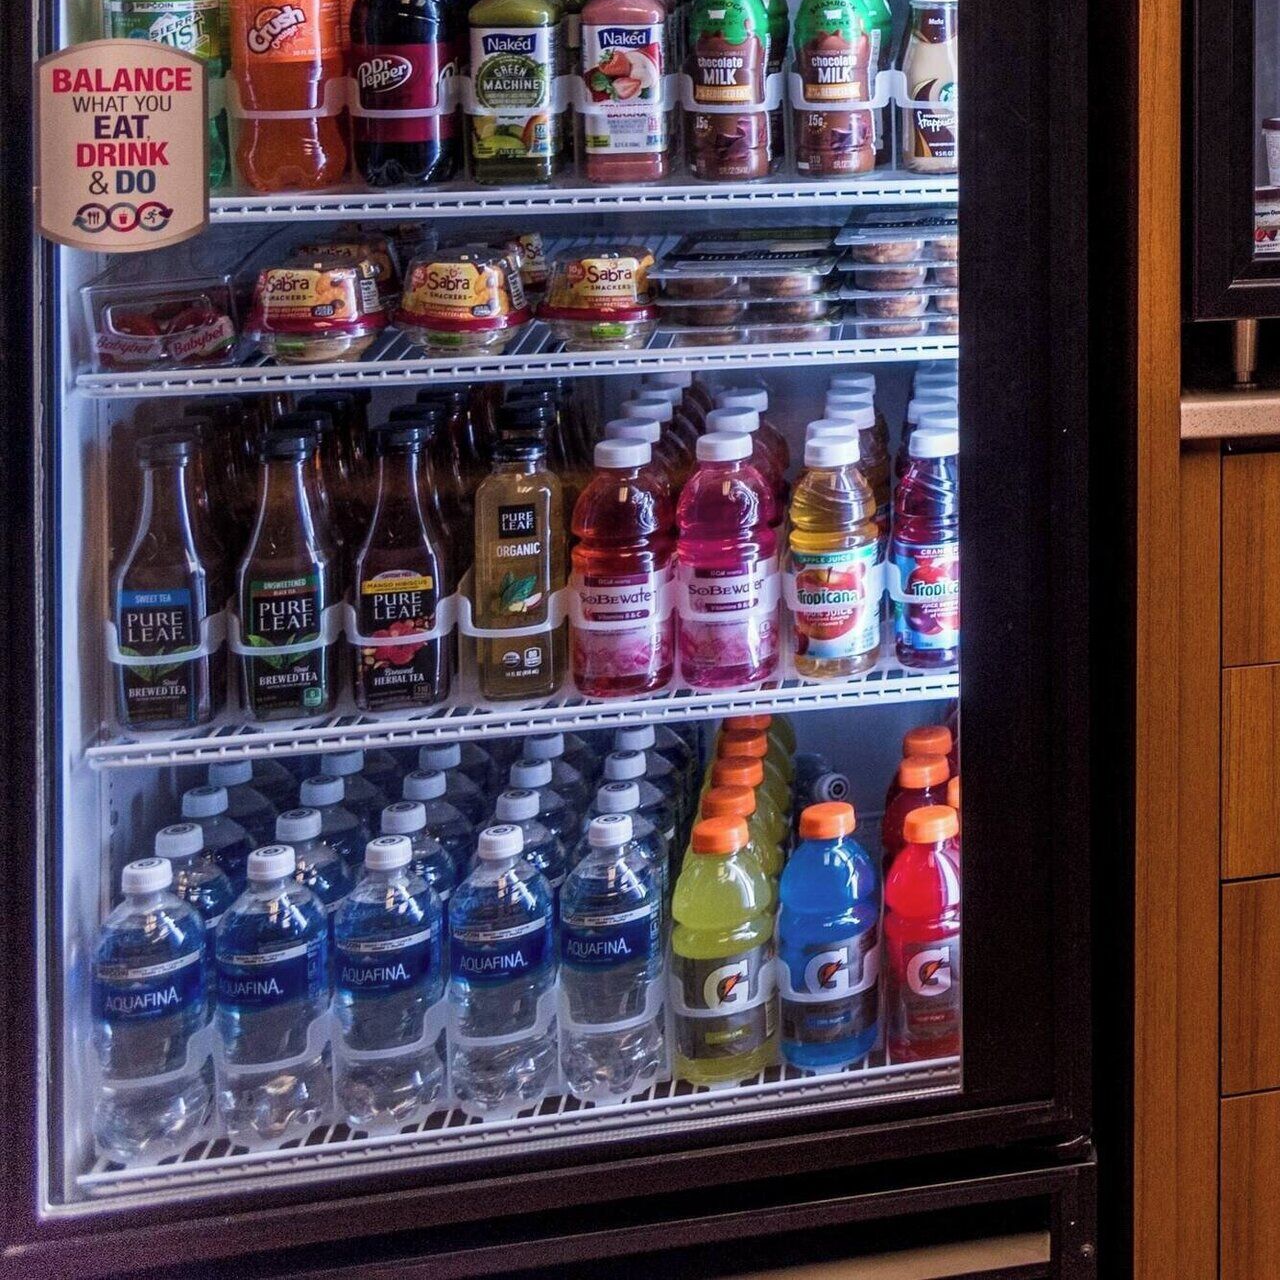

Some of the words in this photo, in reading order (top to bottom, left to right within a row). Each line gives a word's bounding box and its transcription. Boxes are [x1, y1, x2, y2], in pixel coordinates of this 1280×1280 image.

[247, 4, 306, 54] Crush
[371, 57, 391, 74] Dr
[52, 67, 192, 93] BALANCE
[357, 61, 409, 89] Pepper
[703, 69, 736, 85] MILK
[818, 68, 850, 83] MILK
[484, 79, 539, 90] MACHINE
[73, 96, 129, 112] WHAT
[134, 95, 172, 112] YOU
[94, 115, 150, 141] EAT,
[77, 143, 169, 167] DRINK
[88, 170, 108, 195] &
[116, 170, 156, 193] DO
[428, 273, 470, 290] Sabra
[587, 266, 631, 282] Sabra
[266, 277, 310, 292] Sabra
[173, 325, 225, 355] Babybel
[501, 510, 534, 521] PURE
[496, 542, 540, 558] ORGANIC
[260, 599, 314, 615] PURE
[373, 592, 422, 608] PURE
[127, 612, 183, 627] PURE
[259, 674, 299, 686] BREWED
[300, 671, 318, 683] TEA
[374, 674, 405, 684] HERBAL
[129, 687, 167, 698] BREWED
[168, 685, 187, 695] TEA
[567, 939, 630, 957] AQUAFINA
[460, 952, 526, 972] AQUAFINA
[804, 946, 849, 993] G
[342, 964, 409, 984] AQUAFINA
[907, 949, 951, 996] G
[704, 960, 749, 1010] G
[106, 988, 180, 1012] AQUAFINA
